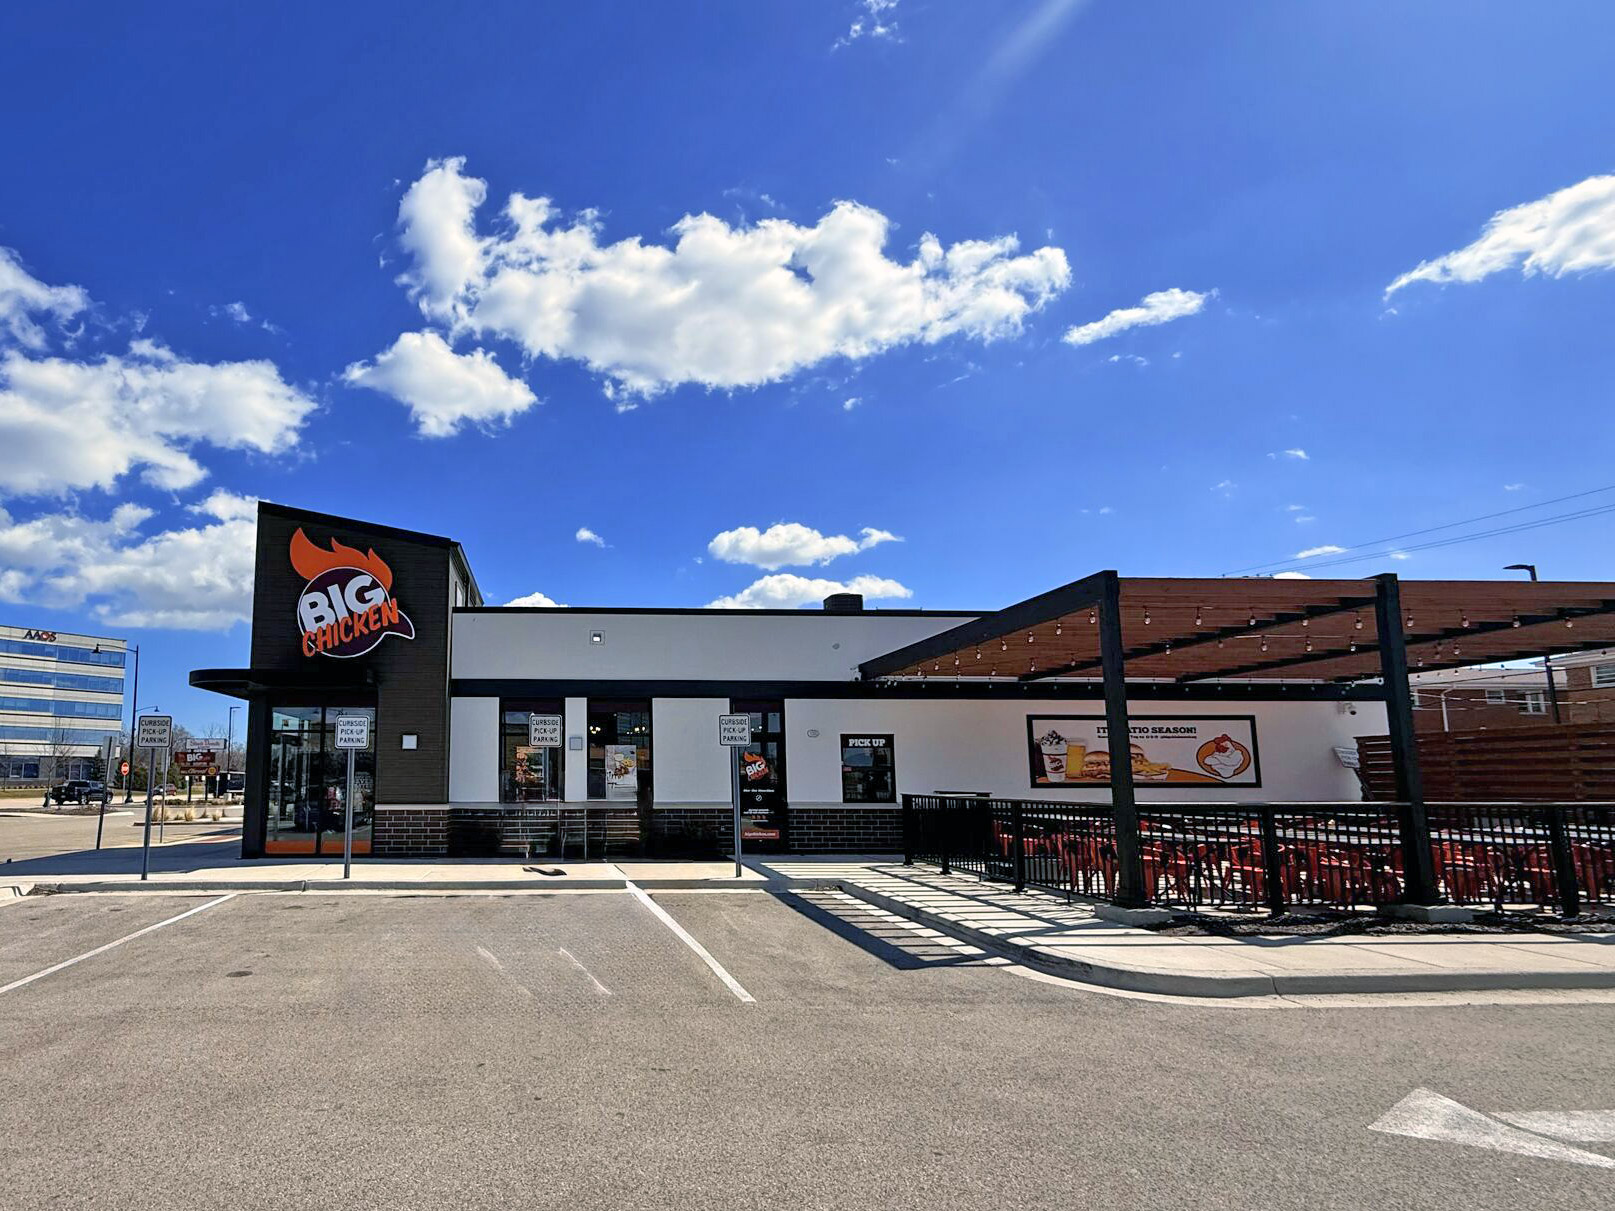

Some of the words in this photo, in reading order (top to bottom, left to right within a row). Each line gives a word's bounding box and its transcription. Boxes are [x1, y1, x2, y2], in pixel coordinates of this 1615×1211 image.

[300, 575, 385, 633] BIG
[302, 598, 399, 657] CHICKEN
[23, 629, 57, 643] AAOS
[140, 719, 170, 727] CURBSIDE
[720, 718, 748, 726] CURBSIDE
[1151, 726, 1197, 734] SEASON!
[848, 738, 871, 747] PICK
[872, 738, 886, 747] UP
[745, 761, 766, 776] BIG
